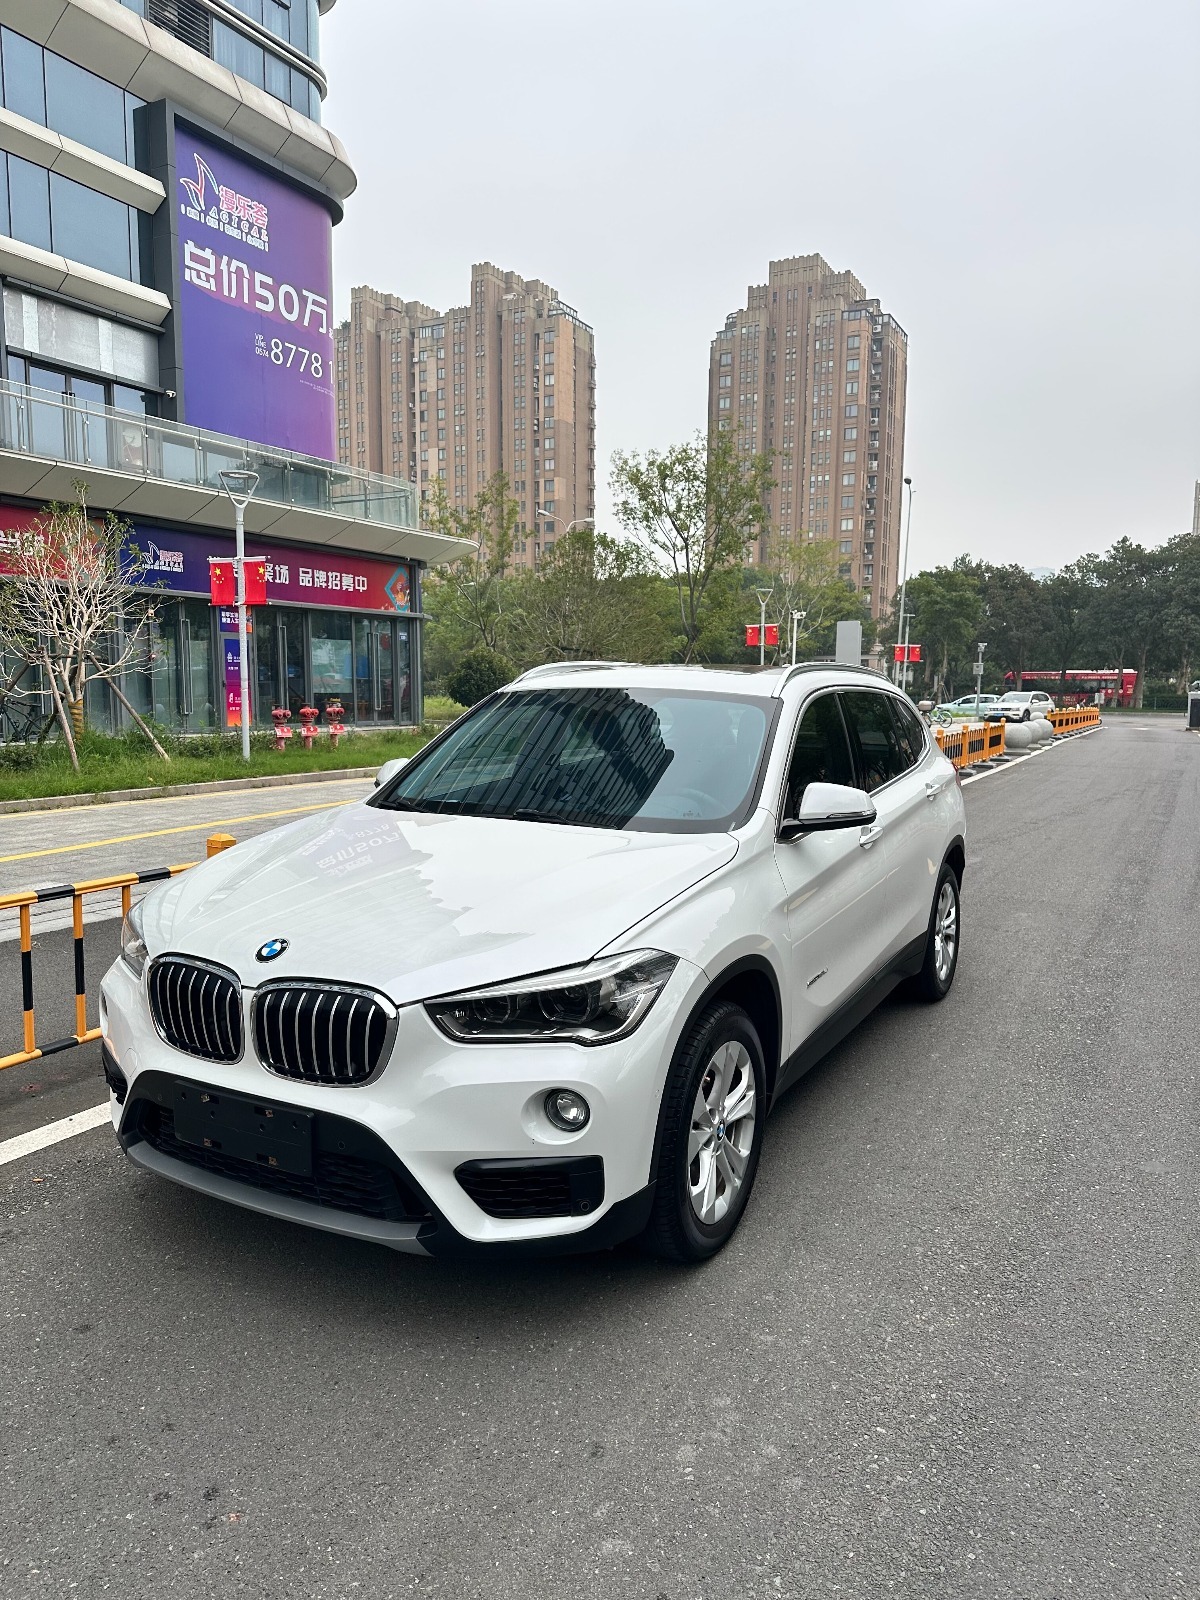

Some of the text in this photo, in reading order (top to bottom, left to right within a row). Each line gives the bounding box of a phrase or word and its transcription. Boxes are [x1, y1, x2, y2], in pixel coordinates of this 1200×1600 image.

[219, 185, 268, 229] 漫乐荟
[271, 338, 323, 378] 8778
[299, 567, 368, 593] 品牌招募中
